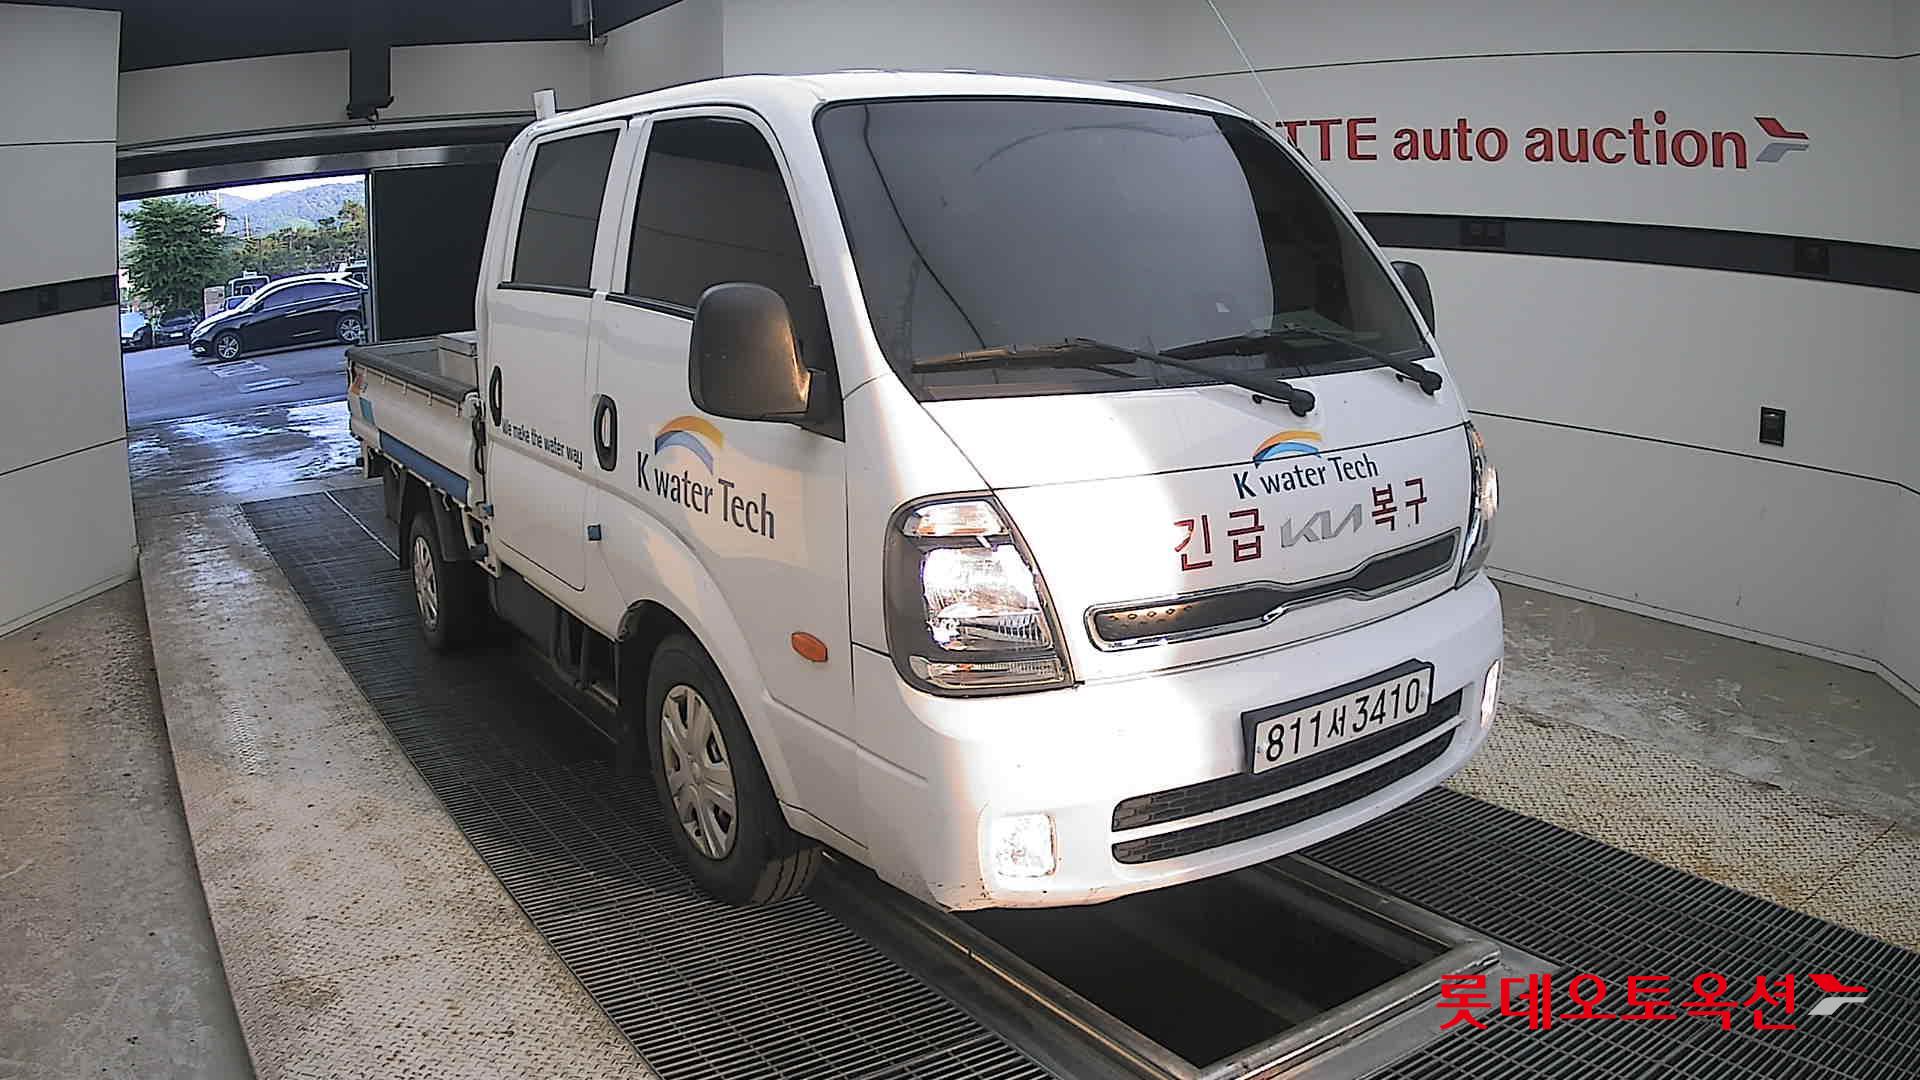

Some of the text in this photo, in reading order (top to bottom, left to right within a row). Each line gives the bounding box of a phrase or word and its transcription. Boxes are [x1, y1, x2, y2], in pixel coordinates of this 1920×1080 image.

[1392, 117, 1508, 162] auto
[1525, 110, 1748, 169] auction
[512, 423, 530, 443] make
[530, 427, 542, 449] the
[543, 436, 565, 456] water
[566, 446, 583, 470] way
[1233, 452, 1378, 499] K water Tech
[637, 451, 775, 539] K water Tech
[1174, 477, 1428, 571] 긴급 복구
